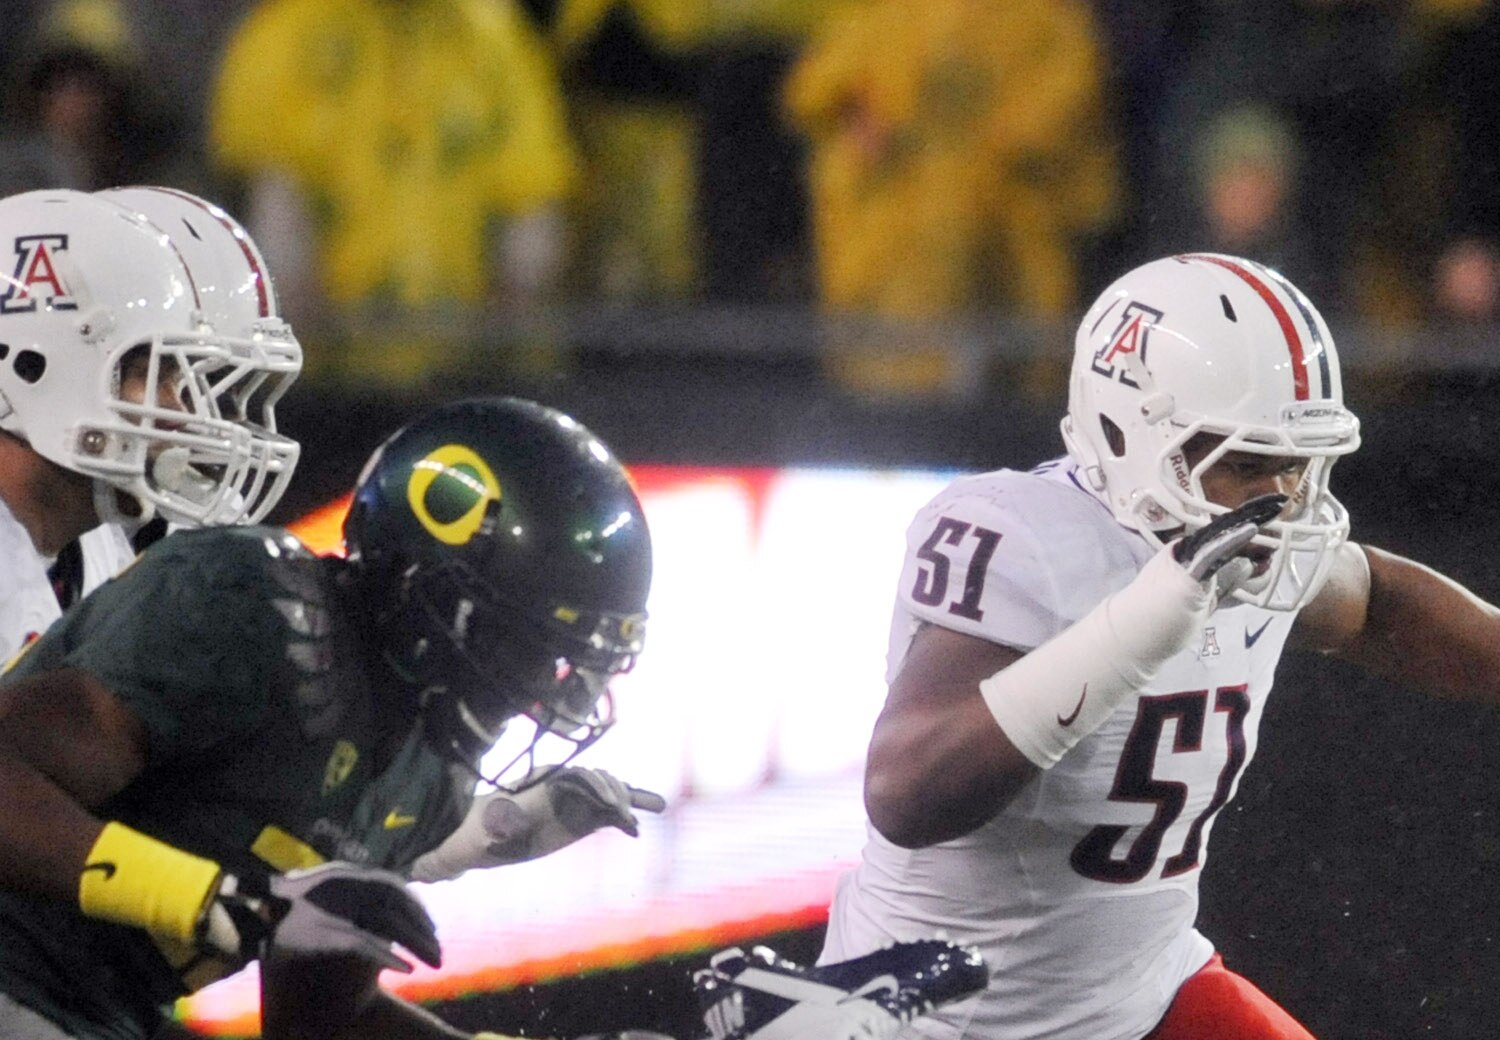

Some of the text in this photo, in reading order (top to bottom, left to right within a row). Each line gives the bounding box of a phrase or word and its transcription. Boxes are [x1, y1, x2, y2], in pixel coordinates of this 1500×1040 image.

[0, 234, 78, 314] A
[1091, 301, 1164, 390] A
[910, 516, 1003, 622] 51
[1070, 682, 1251, 884] 51
